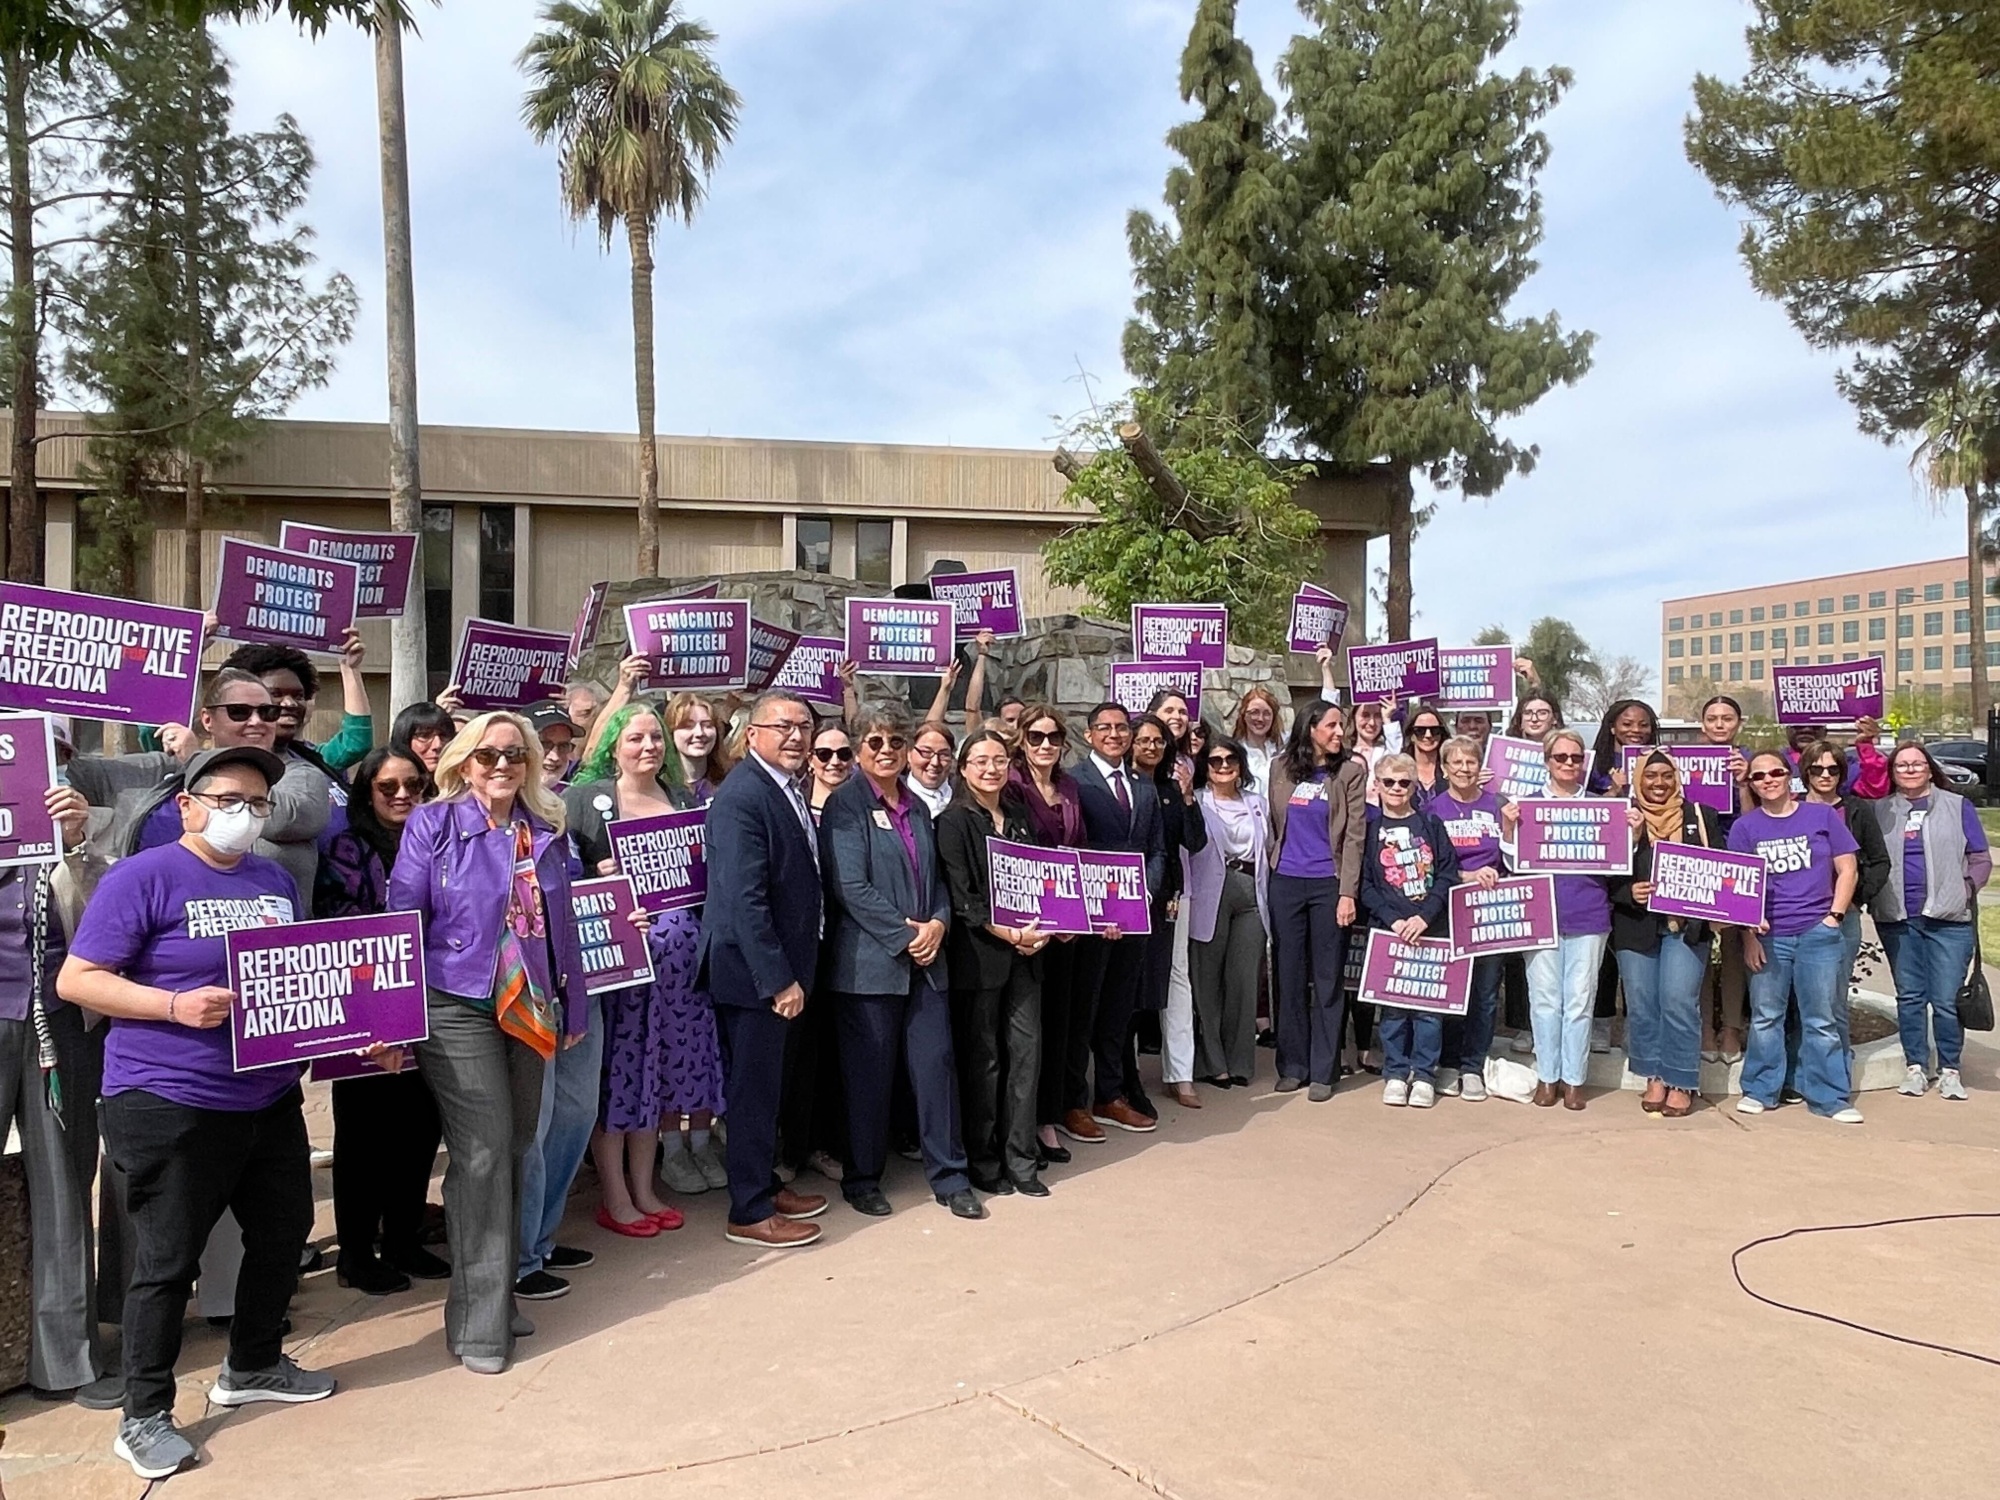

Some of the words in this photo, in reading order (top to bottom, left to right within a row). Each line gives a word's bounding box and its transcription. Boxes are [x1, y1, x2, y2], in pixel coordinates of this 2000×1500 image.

[308, 538, 396, 561] DEMOCRATS
[246, 555, 334, 589] DEMOCRATS
[255, 582, 322, 612] PROTECT
[934, 580, 1012, 599] REPRODUCTIVE
[955, 597, 983, 611] EDOM
[991, 595, 1014, 609] ALL
[246, 606, 326, 637] ABORTION
[648, 609, 734, 630] DEMÓCRATAS
[862, 606, 939, 625] DEMÓCRATAS
[955, 610, 980, 624] ZONA
[1142, 617, 1223, 632] REPRODUCTIVE
[1, 603, 193, 654] REPRODUCTIVE
[870, 626, 931, 643] PROTEGEN
[1142, 631, 1192, 644] FREEDOM
[1201, 631, 1222, 645] ALL
[661, 633, 726, 652] PROTEGEN
[1143, 643, 1187, 656] ARIZONA
[0, 631, 122, 670] FREEDOM
[142, 650, 188, 679] ALL
[470, 643, 565, 669] REPRODUCTIVE
[868, 645, 883, 661] EL
[887, 647, 936, 663] ABORTO
[1352, 647, 1435, 670] REPRODUCTIVE
[0, 656, 107, 694] ARIZONA
[466, 660, 531, 683] FREEDOM
[539, 667, 561, 685] ALL
[659, 658, 674, 675] EL
[680, 655, 730, 675] ABORTO
[1354, 664, 1407, 681] FREEDOM
[1416, 659, 1436, 674] ALL
[1115, 672, 1198, 687] REPRODUCTIVE
[1355, 676, 1404, 693] ARIZONA
[1443, 670, 1490, 683] PROTECT
[1778, 668, 1879, 689] REPRODUCTIVE
[462, 678, 520, 699] ARIZONA
[1439, 685, 1494, 699] ABORTION
[1780, 687, 1844, 701] FREEDOM
[1855, 682, 1880, 699] ALL
[1781, 700, 1840, 713] ARIZONA
[1505, 746, 1544, 765] DEMOC
[1509, 763, 1548, 782] PROTE
[1702, 771, 1726, 785] ALL
[1535, 807, 1610, 822] DEMOCRATS
[616, 823, 706, 857] REPRODUCTI
[1544, 826, 1601, 841] PROTECT
[18, 843, 53, 855] ADLCC
[1540, 844, 1606, 860] ABORTION
[620, 847, 692, 876] FREEDOM
[992, 852, 1077, 882] REPRODUCTIVE
[1659, 852, 1760, 883] REPRODUCTIVE
[635, 867, 691, 895] RIZONA
[993, 871, 1045, 897] FREEDOM
[1055, 880, 1080, 899] ALL
[1117, 881, 1142, 900] ALL
[1657, 867, 1723, 892] FREEDOM
[1733, 879, 1759, 897] ALL
[572, 892, 617, 917] CRATS
[995, 889, 1042, 914] ARIZONA
[1465, 885, 1533, 907] DEMOCRATS
[1655, 882, 1716, 906] ARIZONA
[185, 899, 264, 920] REPRODUC
[1473, 904, 1526, 924] PROTECT
[578, 919, 612, 945] TECT
[1471, 921, 1532, 943] ABORTION
[238, 934, 414, 980] REPRODUCTIVE
[1393, 961, 1447, 980] PROTECT
[240, 967, 352, 1010] FREEDOM
[373, 961, 416, 991] ALL
[1385, 978, 1448, 999] ABORTION
[243, 997, 346, 1039] ARIZONA
